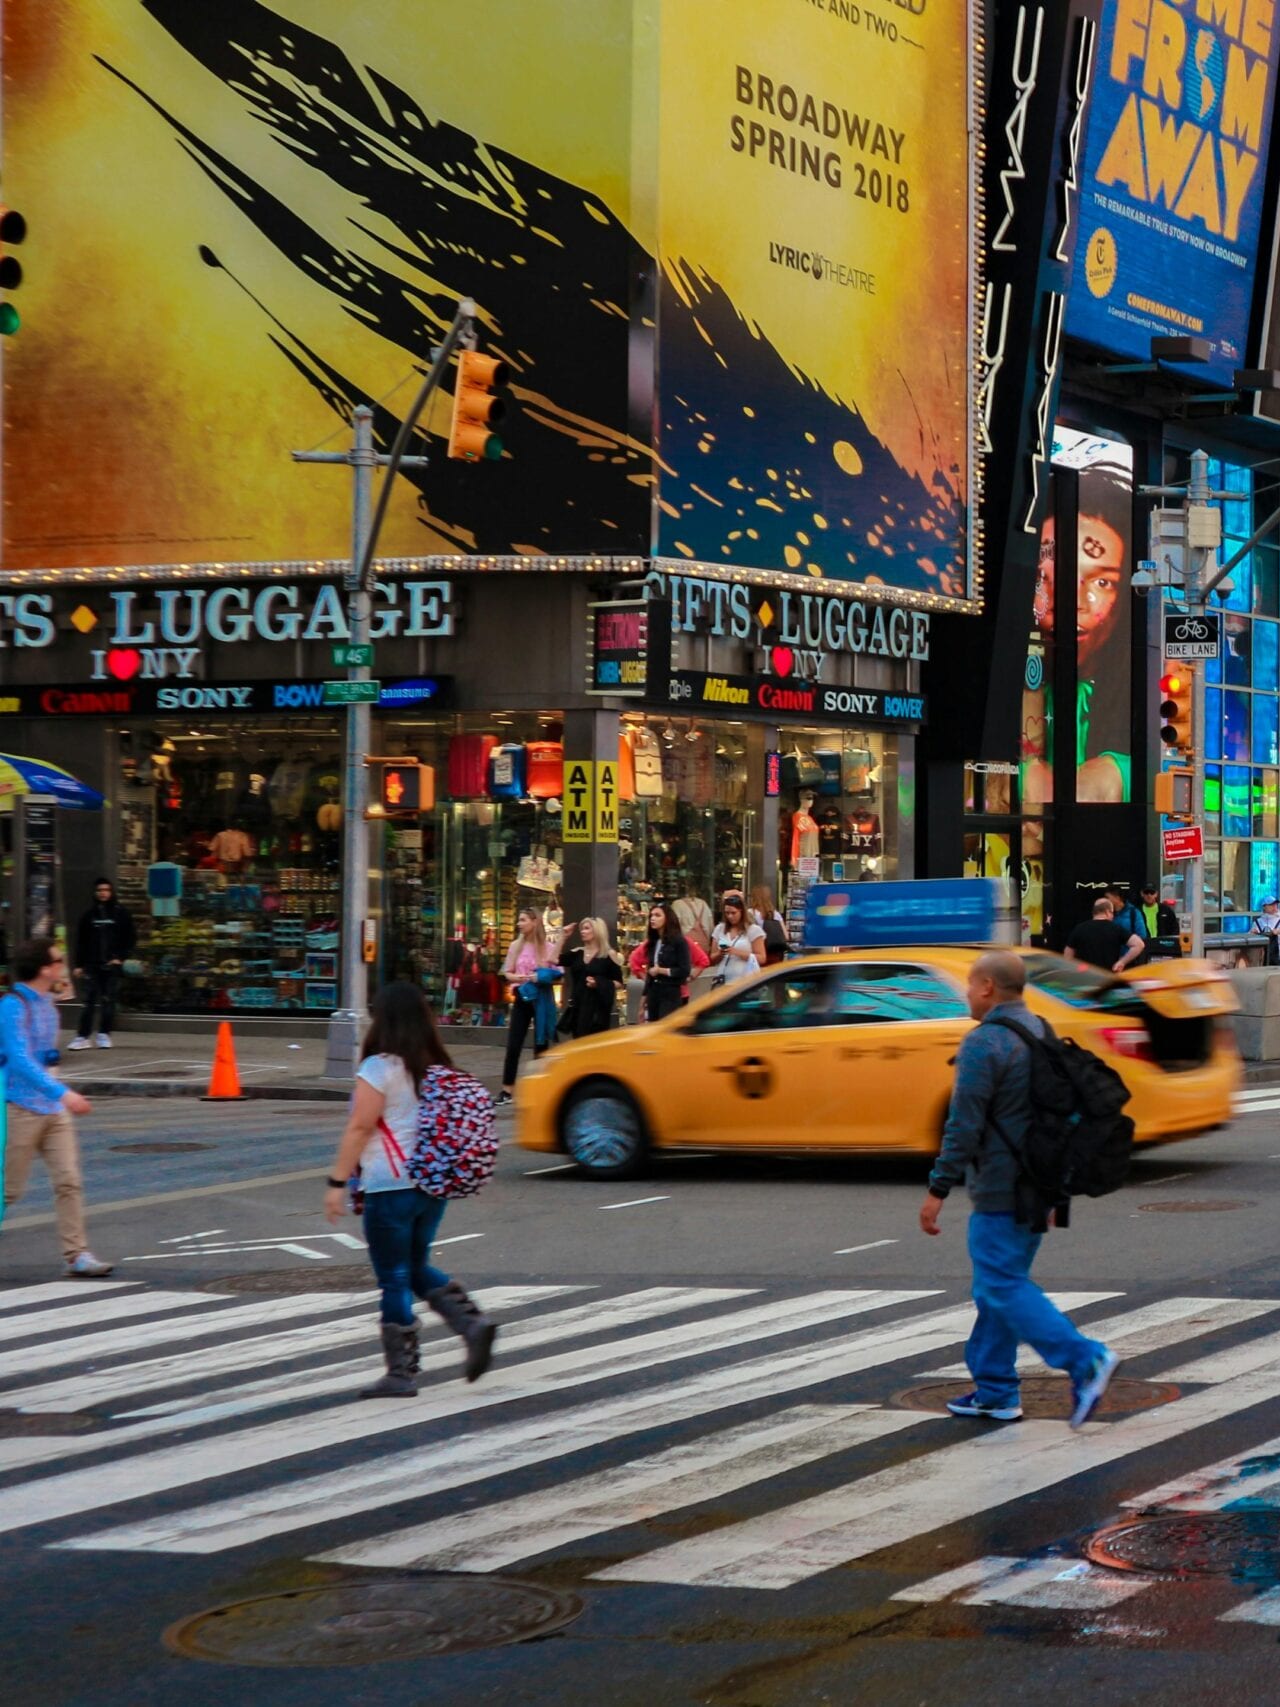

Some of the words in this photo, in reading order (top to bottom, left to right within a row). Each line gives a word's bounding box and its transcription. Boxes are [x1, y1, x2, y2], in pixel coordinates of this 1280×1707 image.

[829, 0, 860, 25] AND
[864, 10, 898, 42] TWO
[736, 64, 906, 165] BROADWAY
[730, 114, 842, 189] SPRING
[854, 162, 910, 214] 2018
[1094, 91, 1259, 241] AWAY
[1093, 192, 1107, 208] THE
[1108, 198, 1151, 228] REMARKABLE
[1151, 217, 1170, 236] TRUE
[1169, 224, 1190, 244] STORY
[1190, 234, 1205, 250] NOW
[1215, 244, 1248, 270] BROADWAY
[769, 241, 811, 273] LYRIC
[823, 258, 876, 295] THEATRE
[109, 580, 454, 645] LUGGAGE
[779, 591, 931, 661] LUGGAGE
[90, 649, 108, 680] I
[138, 647, 201, 679] NY
[762, 646, 772, 675] I
[792, 648, 827, 683] NY
[1167, 644, 1188, 656] BIKE
[1191, 643, 1216, 656] LANE
[41, 690, 131, 714] Canon
[156, 686, 254, 709] SONY
[274, 684, 327, 707] BOW
[380, 687, 431, 699] SAMSUNG
[702, 677, 750, 705] Nikon
[757, 683, 814, 712] Canon
[824, 691, 878, 715] SONY
[884, 695, 925, 720] BOWER
[568, 765, 588, 830] ATM
[600, 765, 615, 830] ATM
